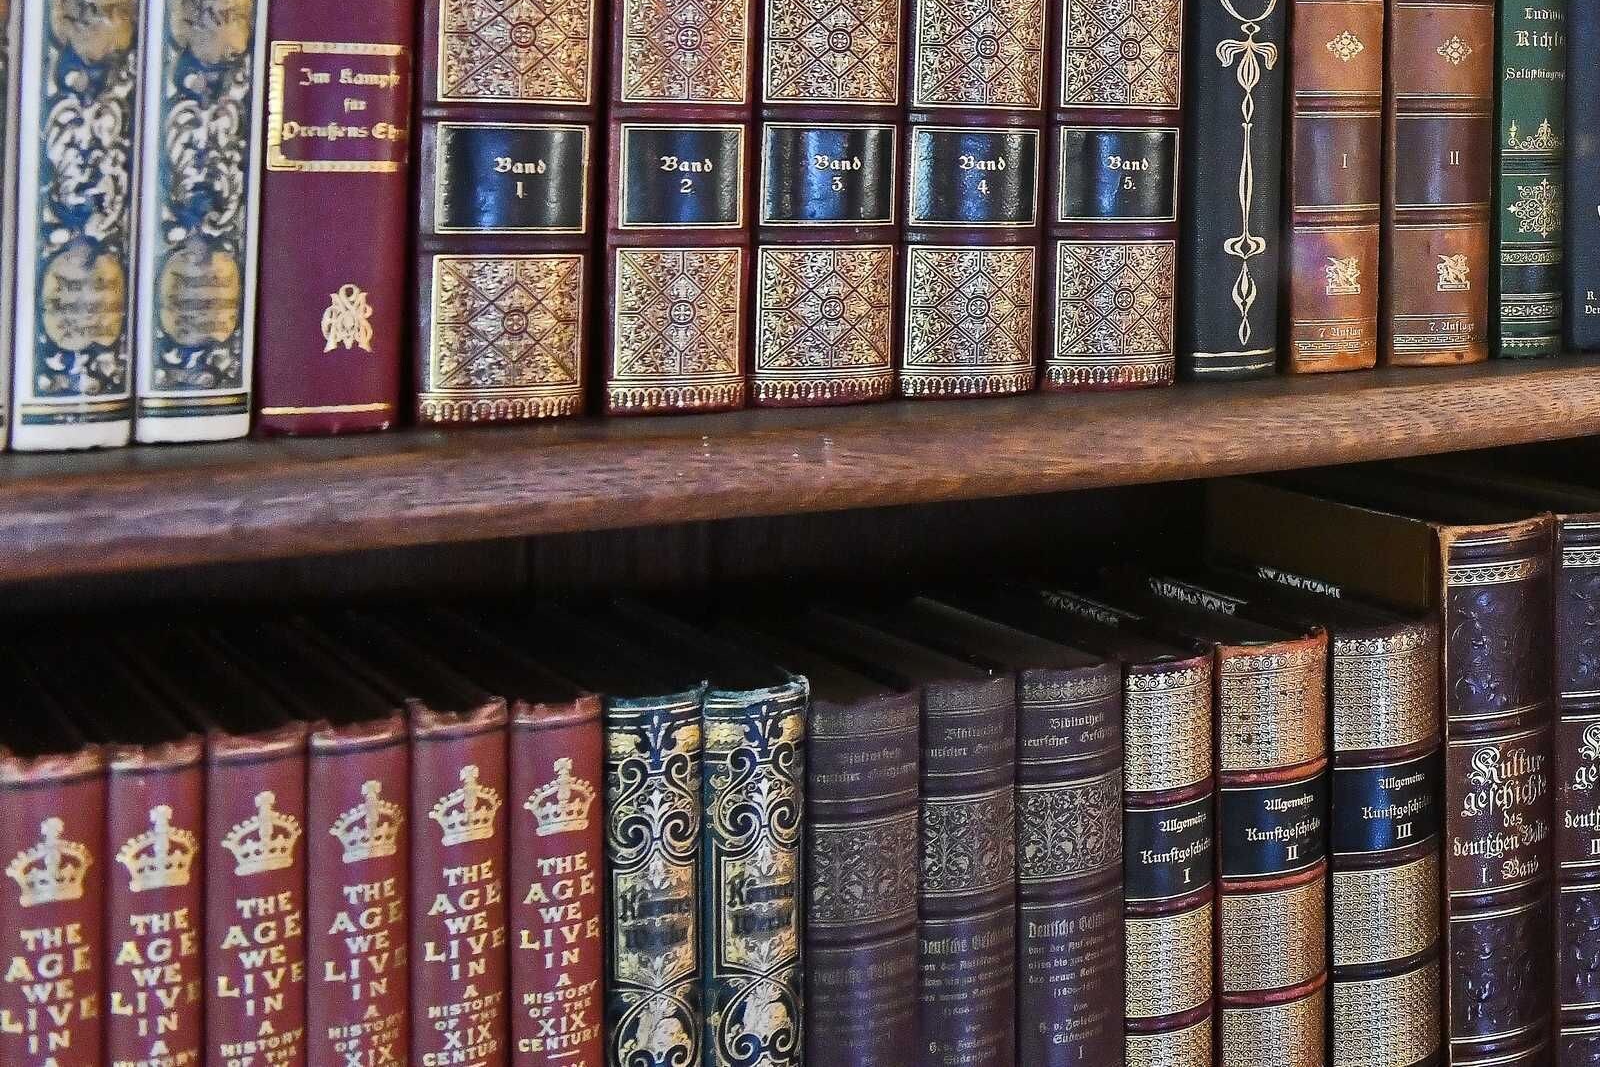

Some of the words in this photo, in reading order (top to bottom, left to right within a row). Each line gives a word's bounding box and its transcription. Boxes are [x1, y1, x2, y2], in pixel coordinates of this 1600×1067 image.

[494, 156, 546, 175] Band
[660, 156, 713, 174] Band
[813, 155, 862, 172] Band
[959, 155, 1006, 172] Band
[1107, 155, 1150, 172] Band
[1341, 153, 1348, 170] I
[1449, 150, 1461, 166] II
[1586, 290, 1598, 301] R.
[1395, 821, 1414, 841] III
[1503, 809, 1524, 829] des
[1285, 845, 1300, 862] II
[1453, 831, 1521, 859] deutschen
[442, 859, 494, 887] THE
[536, 851, 589, 877] THE
[1183, 867, 1191, 884] I
[1481, 865, 1494, 885] I.
[342, 877, 396, 905] THE
[427, 883, 503, 916] AGE
[522, 871, 596, 905] AGE
[236, 890, 293, 919] THE
[328, 899, 402, 934] AGE
[538, 901, 583, 924] WE
[129, 907, 190, 936] THE
[220, 910, 302, 950] AGE
[443, 911, 489, 935] WE
[518, 915, 601, 951] LIVE
[19, 922, 82, 952] THE
[115, 930, 198, 966] AGE
[344, 929, 392, 954] WE
[423, 926, 506, 962] LIVE
[5, 945, 93, 982] AGE
[238, 944, 287, 970] WE
[449, 957, 487, 981] IN
[543, 947, 580, 970] IN
[131, 962, 183, 987] WE
[217, 960, 304, 998] LIVE
[555, 972, 573, 988] A
[22, 979, 75, 1003] WE
[350, 977, 389, 1001] IN
[463, 984, 480, 999] A
[522, 979, 599, 1007] HISTORY
[0, 994, 98, 1034] LIVE
[245, 993, 285, 1018] IN
[362, 1004, 382, 1019] A
[528, 1005, 553, 1019] OF
[563, 997, 593, 1014] THE
[138, 1011, 179, 1038] IN
[257, 1020, 275, 1036] A
[433, 1018, 458, 1031] OF
[444, 1021, 493, 1050] XIX
[536, 1010, 588, 1037] XIX
[28, 1029, 72, 1055] IN
[334, 1039, 360, 1053] OF
[517, 1023, 601, 1053] CENTURY
